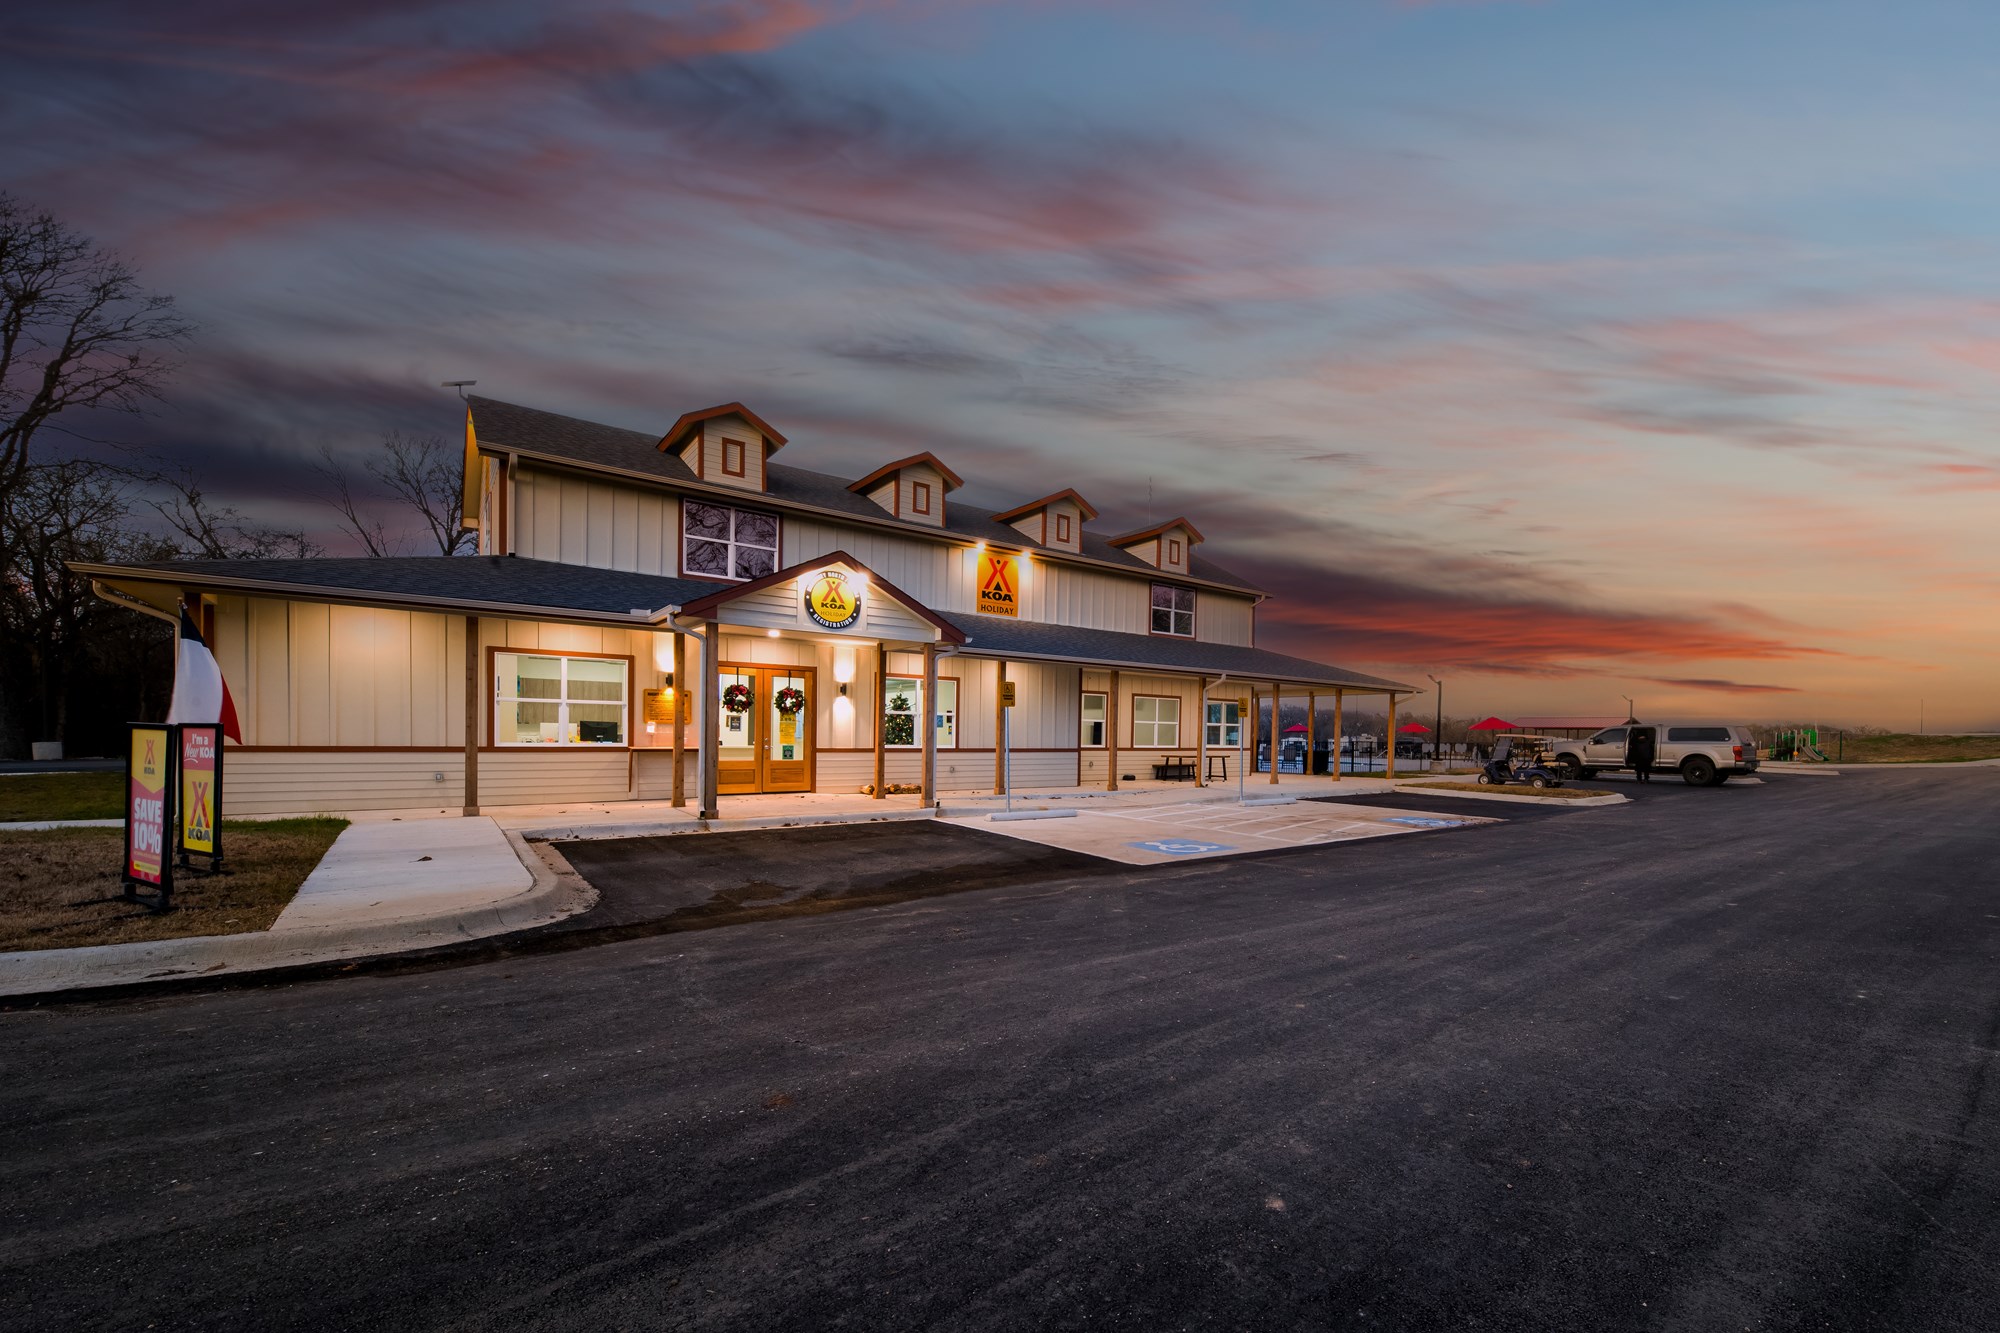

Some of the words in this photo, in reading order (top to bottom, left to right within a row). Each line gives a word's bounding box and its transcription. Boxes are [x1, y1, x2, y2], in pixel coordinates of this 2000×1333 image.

[982, 590, 1013, 602] KOA
[821, 602, 846, 610] KOA
[981, 604, 1014, 615] HOLIDAY
[813, 613, 853, 628] REGISTRATION
[192, 733, 203, 745] I'm
[203, 736, 209, 745] a
[184, 742, 199, 758] New
[199, 747, 215, 759] KOA
[144, 767, 155, 775] KOA
[134, 797, 162, 823] SAVE
[134, 821, 161, 854] 10%
[188, 827, 211, 842] KOA
